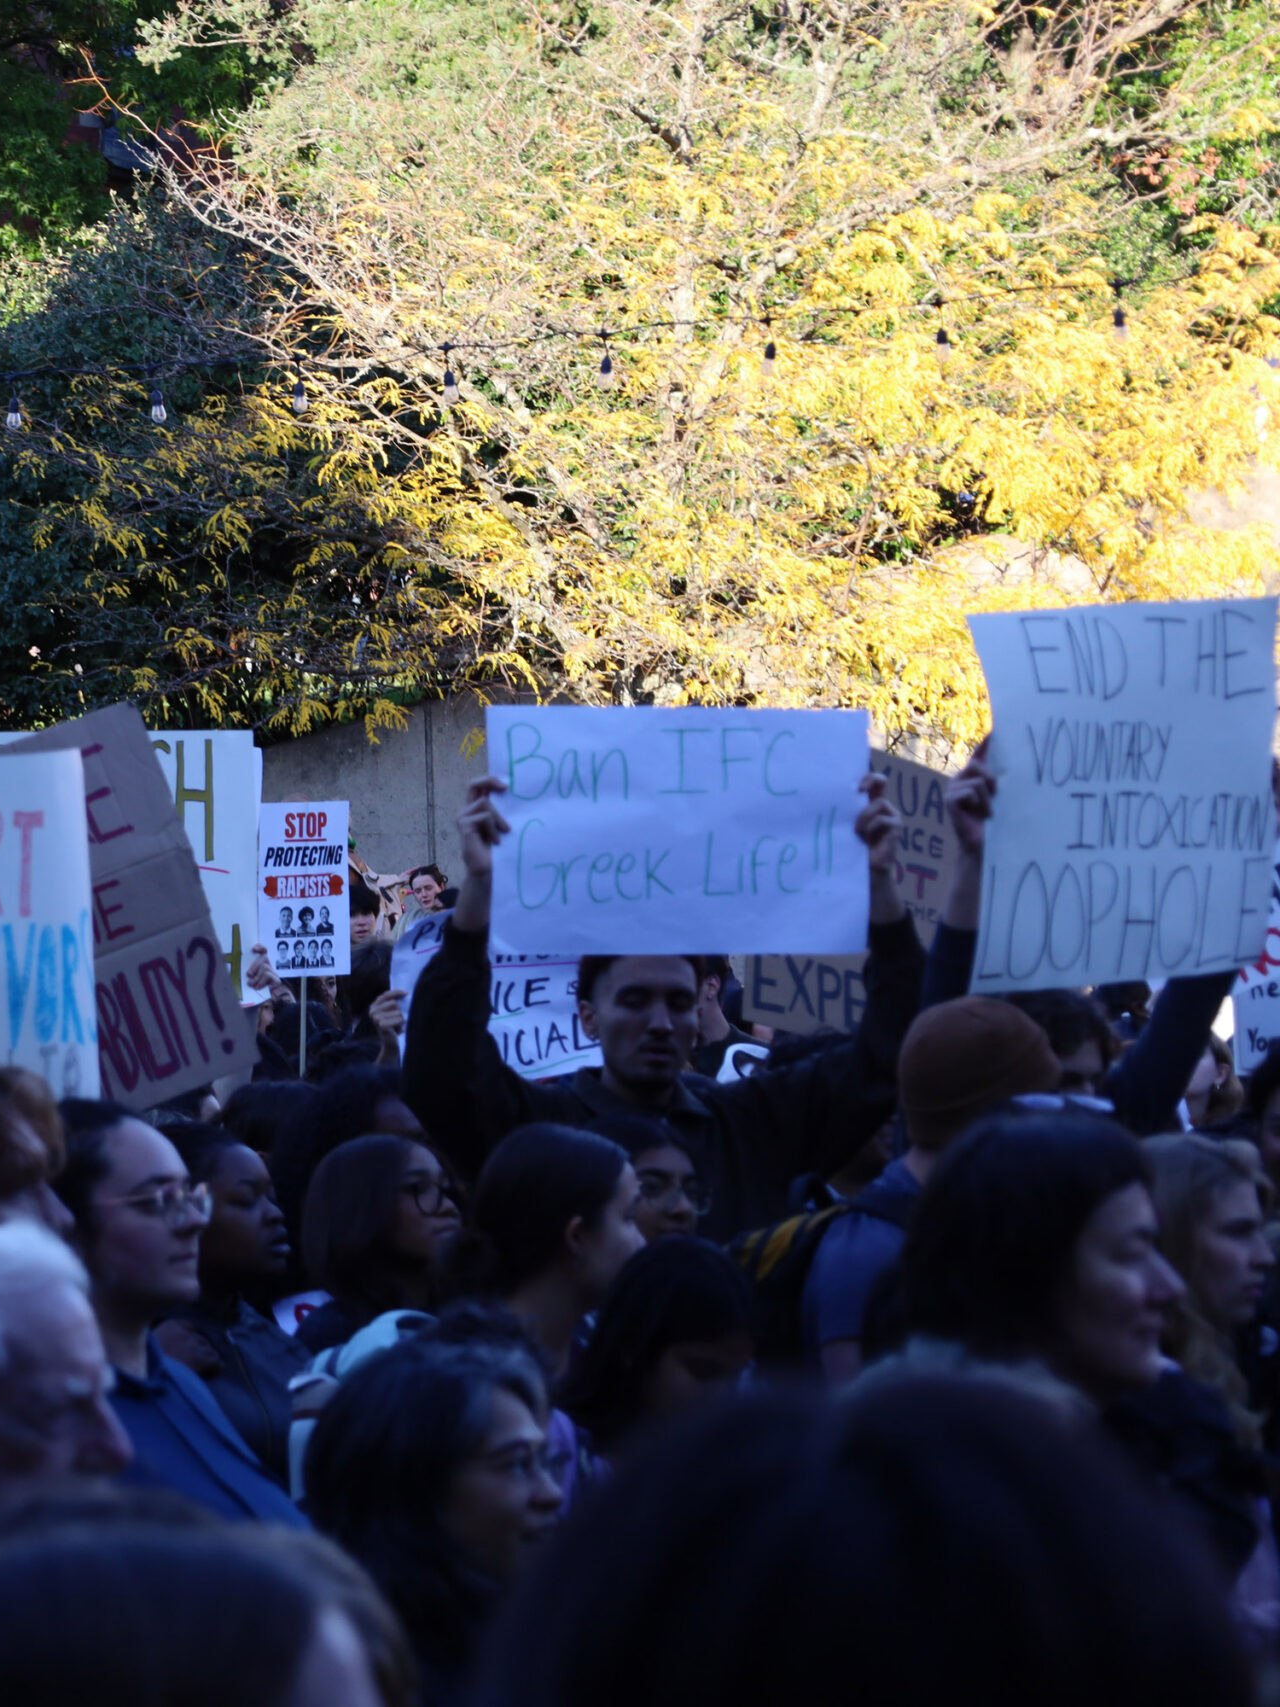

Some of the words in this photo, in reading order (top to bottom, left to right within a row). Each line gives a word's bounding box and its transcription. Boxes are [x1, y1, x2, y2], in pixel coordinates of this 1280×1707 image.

[1020, 616, 1128, 701] END
[1144, 609, 1266, 700] THE
[506, 722, 630, 802] Ban
[658, 727, 798, 797] IFC
[1027, 715, 1173, 787] VOLUNTARY
[264, 845, 343, 867] PROTECTING
[284, 812, 328, 838] STOP
[1066, 791, 1272, 852] INTOXICATION
[277, 876, 331, 897] RAPISTS
[516, 818, 675, 910] Greek
[978, 856, 1271, 981] LOOPHOLE
